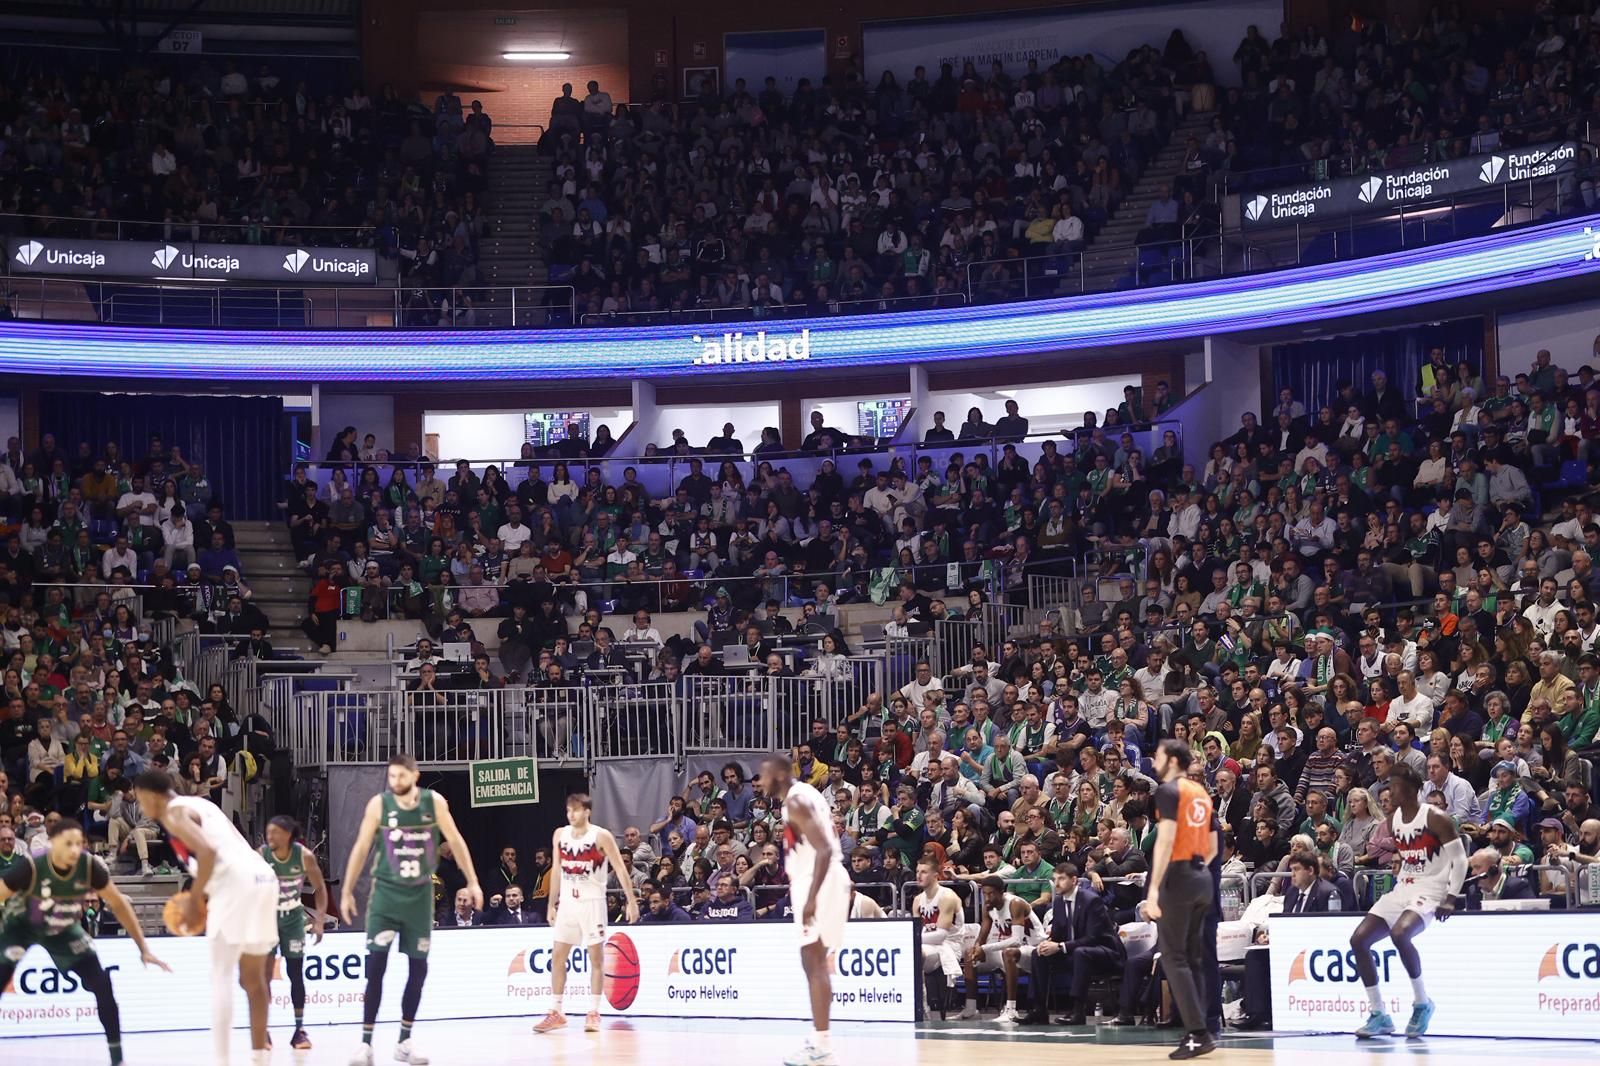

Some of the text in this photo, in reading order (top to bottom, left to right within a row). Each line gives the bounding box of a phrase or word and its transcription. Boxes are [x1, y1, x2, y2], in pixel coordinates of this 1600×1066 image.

[1385, 166, 1449, 188] Fundación
[1271, 186, 1331, 207] Fundación
[1386, 183, 1432, 201] Unicaja
[1271, 202, 1315, 218] Unicaja
[46, 249, 105, 269] Unicaja
[181, 253, 240, 273] Unicaja
[312, 258, 369, 275] Unicaja
[478, 767, 529, 783] SALIDA DE
[475, 782, 533, 799] EMERGENCIA
[681, 947, 737, 975] caser
[838, 948, 901, 977] caser
[668, 984, 738, 1003] Grupo Helvetia
[832, 987, 902, 1007] rupo Helvetia
[1288, 993, 1355, 1017] Preparados
[1391, 997, 1400, 1013] ti
